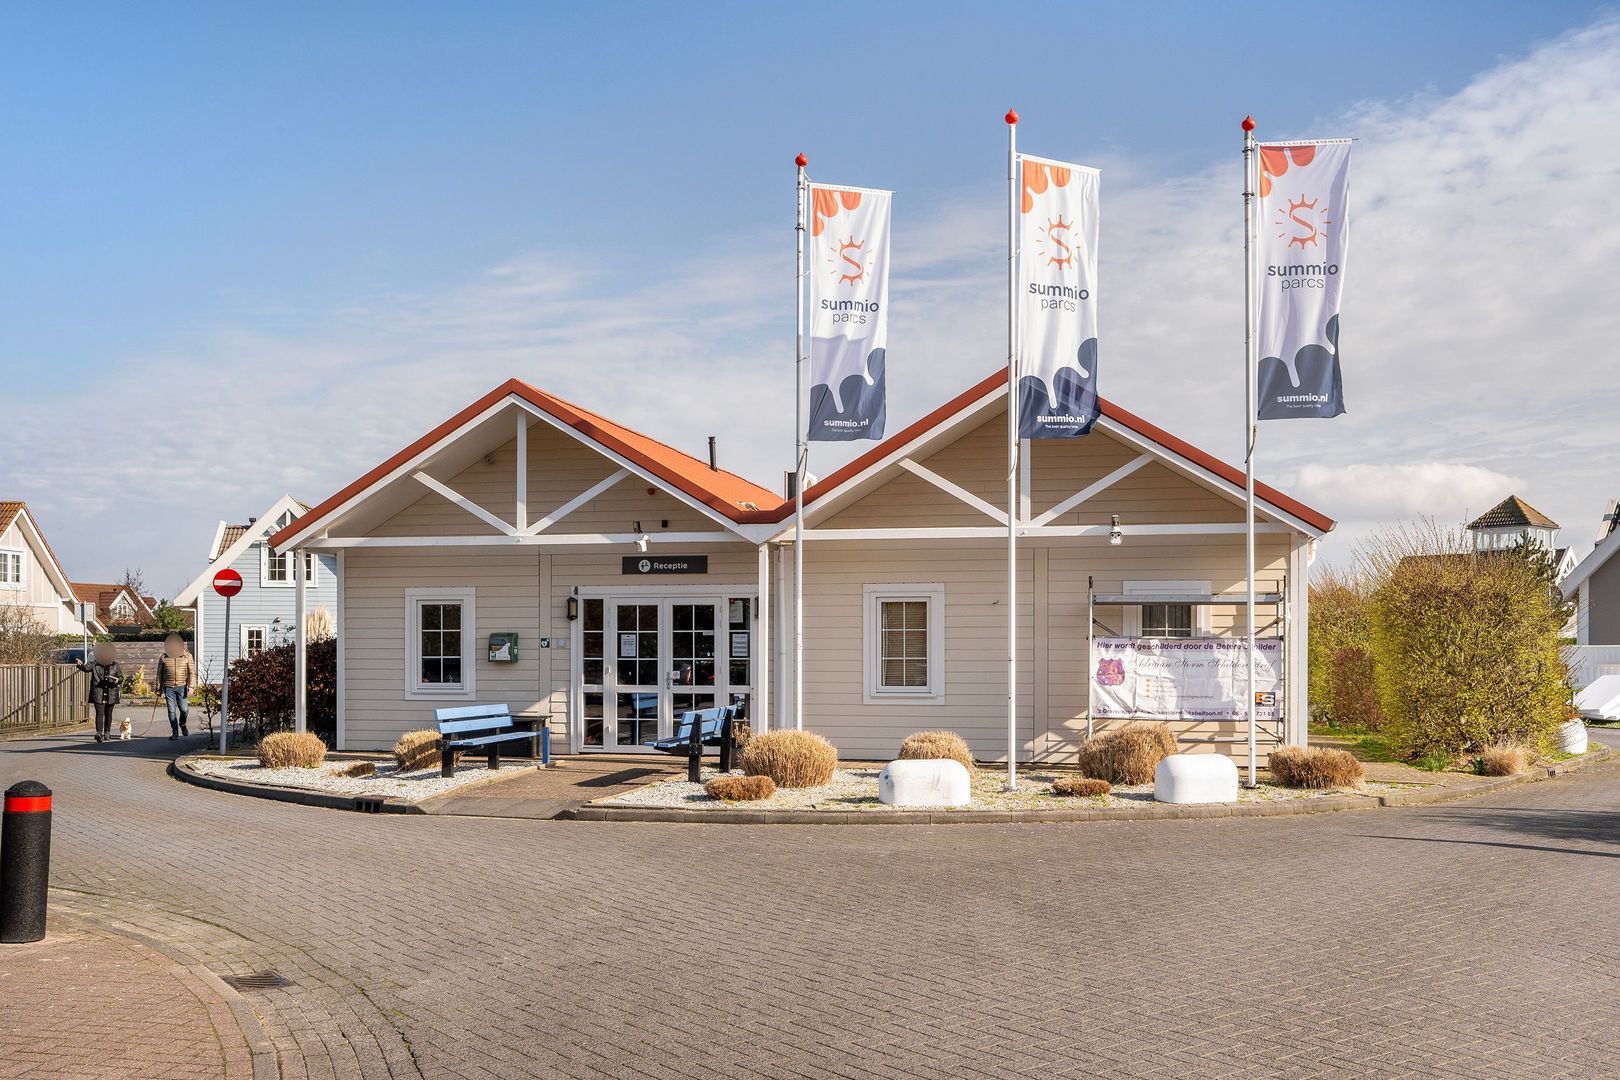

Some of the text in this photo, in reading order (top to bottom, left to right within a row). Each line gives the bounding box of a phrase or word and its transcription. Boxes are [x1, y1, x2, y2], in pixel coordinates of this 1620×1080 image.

[1268, 262, 1339, 276] summio
[1029, 282, 1089, 300] summio
[1281, 278, 1324, 292] parcs
[821, 299, 879, 313] summio
[1041, 298, 1076, 312] parcs
[832, 313, 867, 325] parcs
[1276, 392, 1328, 403] summio.nl
[823, 418, 869, 428] summio.nl
[1036, 413, 1085, 423] summio.nl
[653, 562, 688, 570] Receptie
[1097, 641, 1113, 649] Hier
[1137, 642, 1182, 651] geschilderd
